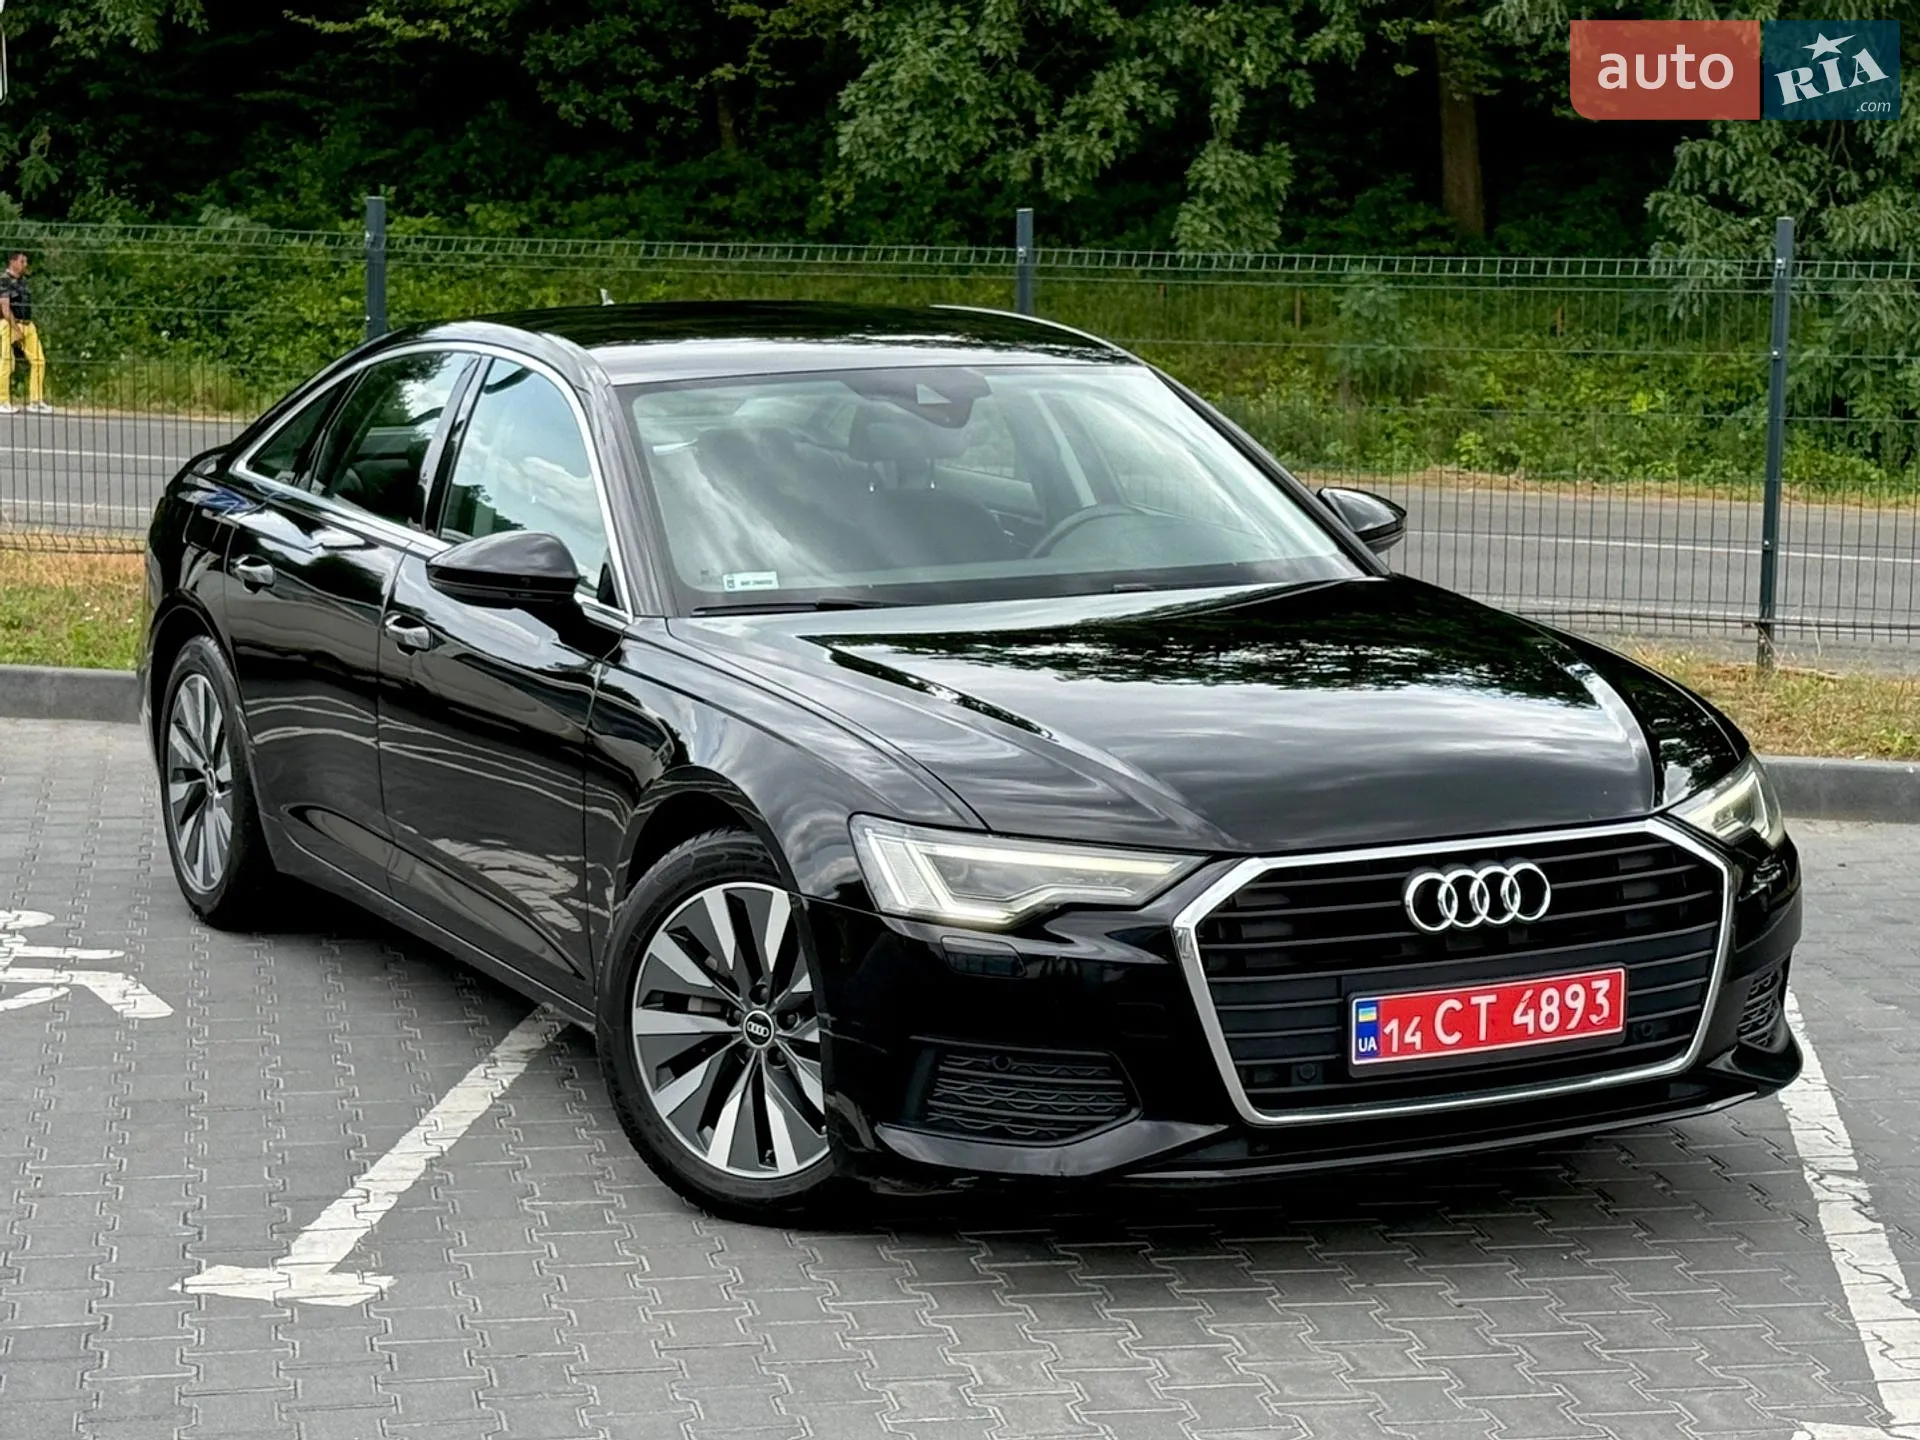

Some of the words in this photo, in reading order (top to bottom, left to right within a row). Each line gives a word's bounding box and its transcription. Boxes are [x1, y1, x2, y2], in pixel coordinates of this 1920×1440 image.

[1383, 1016, 1422, 1053] 14
[1434, 994, 1497, 1045] CT
[1512, 979, 1610, 1035] 4893
[1359, 1036, 1377, 1052] UA
